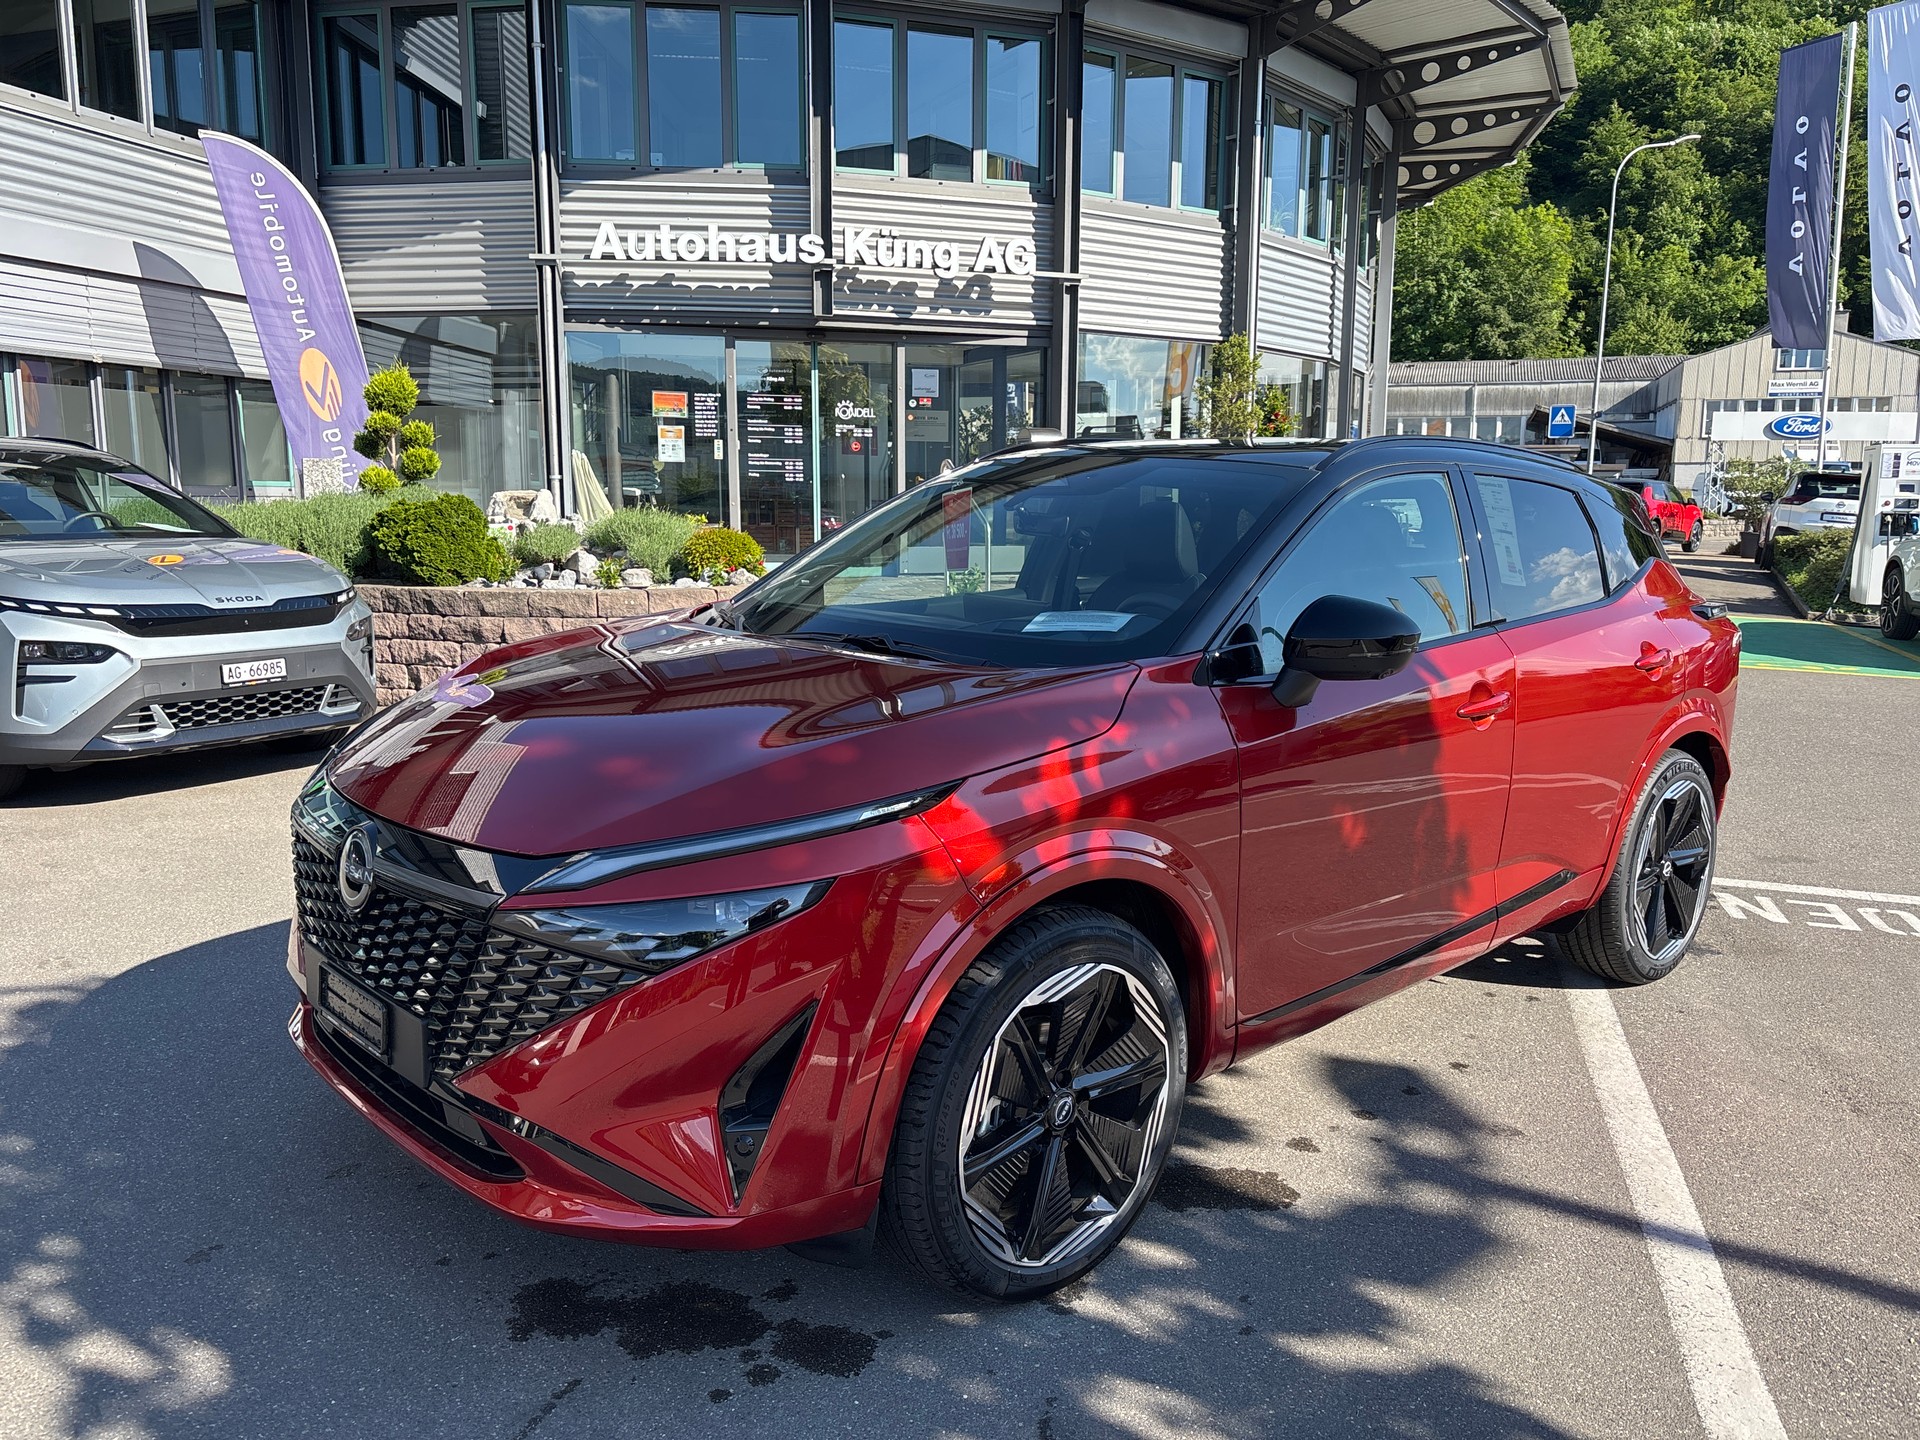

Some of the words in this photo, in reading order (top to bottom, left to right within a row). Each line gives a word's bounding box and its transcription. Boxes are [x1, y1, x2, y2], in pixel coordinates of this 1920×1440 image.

[590, 221, 826, 264] Autohaus
[844, 226, 959, 279] Küng
[973, 236, 1037, 276] AG
[1783, 417, 1821, 433] Ford
[248, 661, 283, 677] 66985
